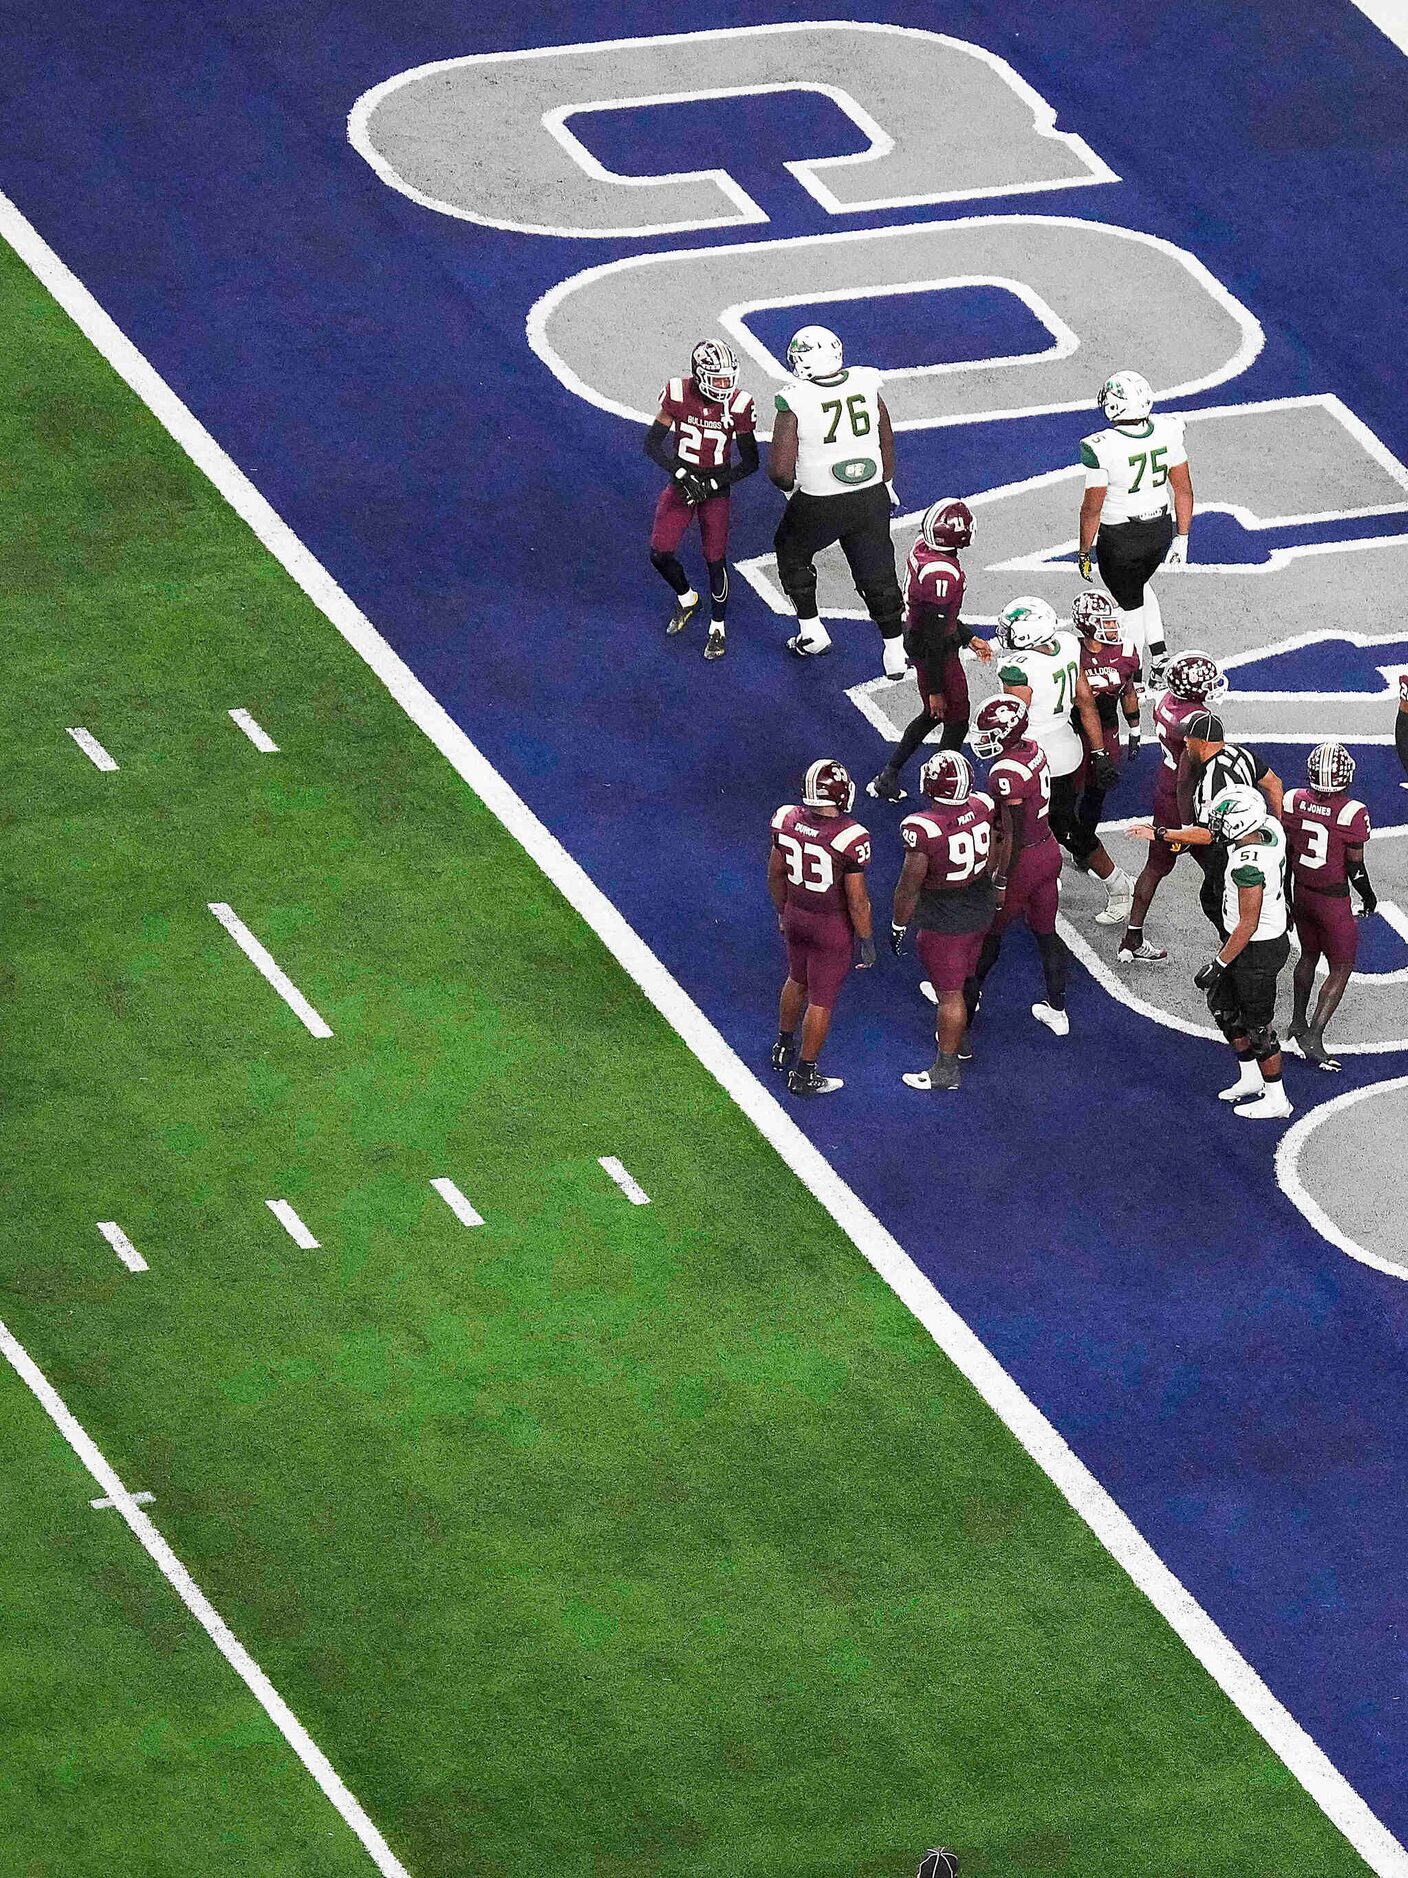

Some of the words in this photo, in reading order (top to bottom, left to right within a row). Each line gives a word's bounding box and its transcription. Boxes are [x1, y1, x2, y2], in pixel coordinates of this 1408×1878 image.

[688, 415, 722, 429] BULLDOGS
[821, 394, 870, 444] 76
[678, 421, 727, 466] 27
[1128, 446, 1168, 494] 75
[935, 579, 949, 597] 11
[1052, 661, 1079, 715] 70
[998, 777, 1011, 796] 9
[1308, 803, 1332, 817] JONES
[778, 832, 834, 893] 33
[854, 841, 872, 864] 33
[945, 820, 991, 881] 99
[1240, 851, 1259, 862] 51
[1299, 819, 1329, 870] 3
